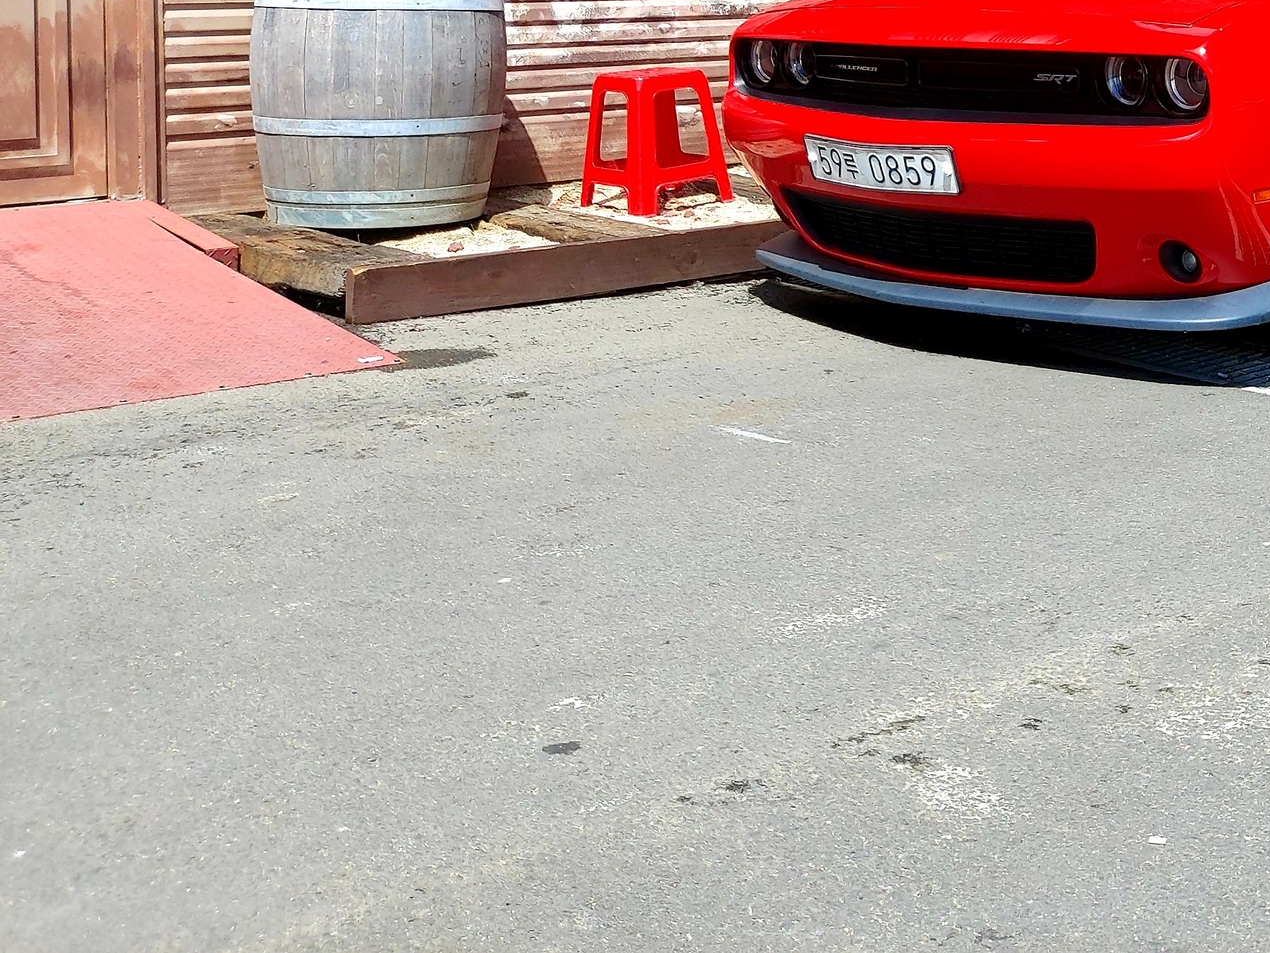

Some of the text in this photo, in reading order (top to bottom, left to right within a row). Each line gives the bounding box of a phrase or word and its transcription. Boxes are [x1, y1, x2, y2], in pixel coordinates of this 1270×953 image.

[1033, 73, 1078, 85] SRT
[817, 144, 937, 187] 59루 0859
